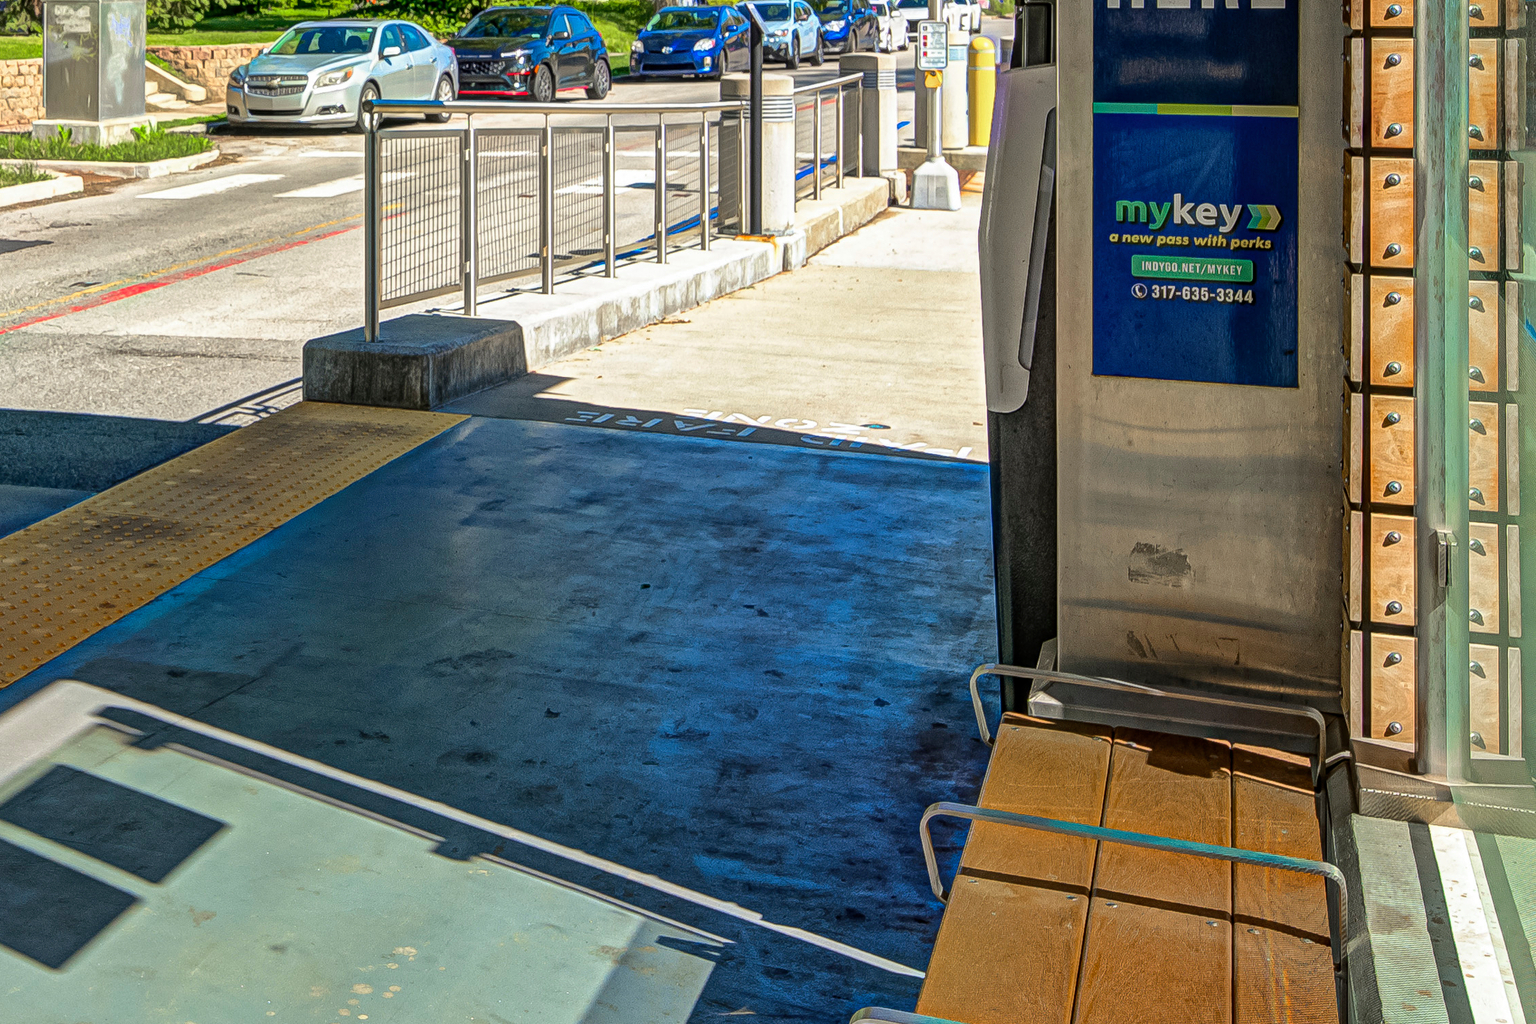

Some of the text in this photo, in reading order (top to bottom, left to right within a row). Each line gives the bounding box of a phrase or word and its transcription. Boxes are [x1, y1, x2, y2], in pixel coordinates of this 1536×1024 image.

[1116, 193, 1242, 233] mykey
[1109, 233, 1272, 250] a new pass with perks
[1141, 260, 1243, 276] INDYGO.NET/MYKEY
[1151, 285, 1254, 304] 317-635-3344
